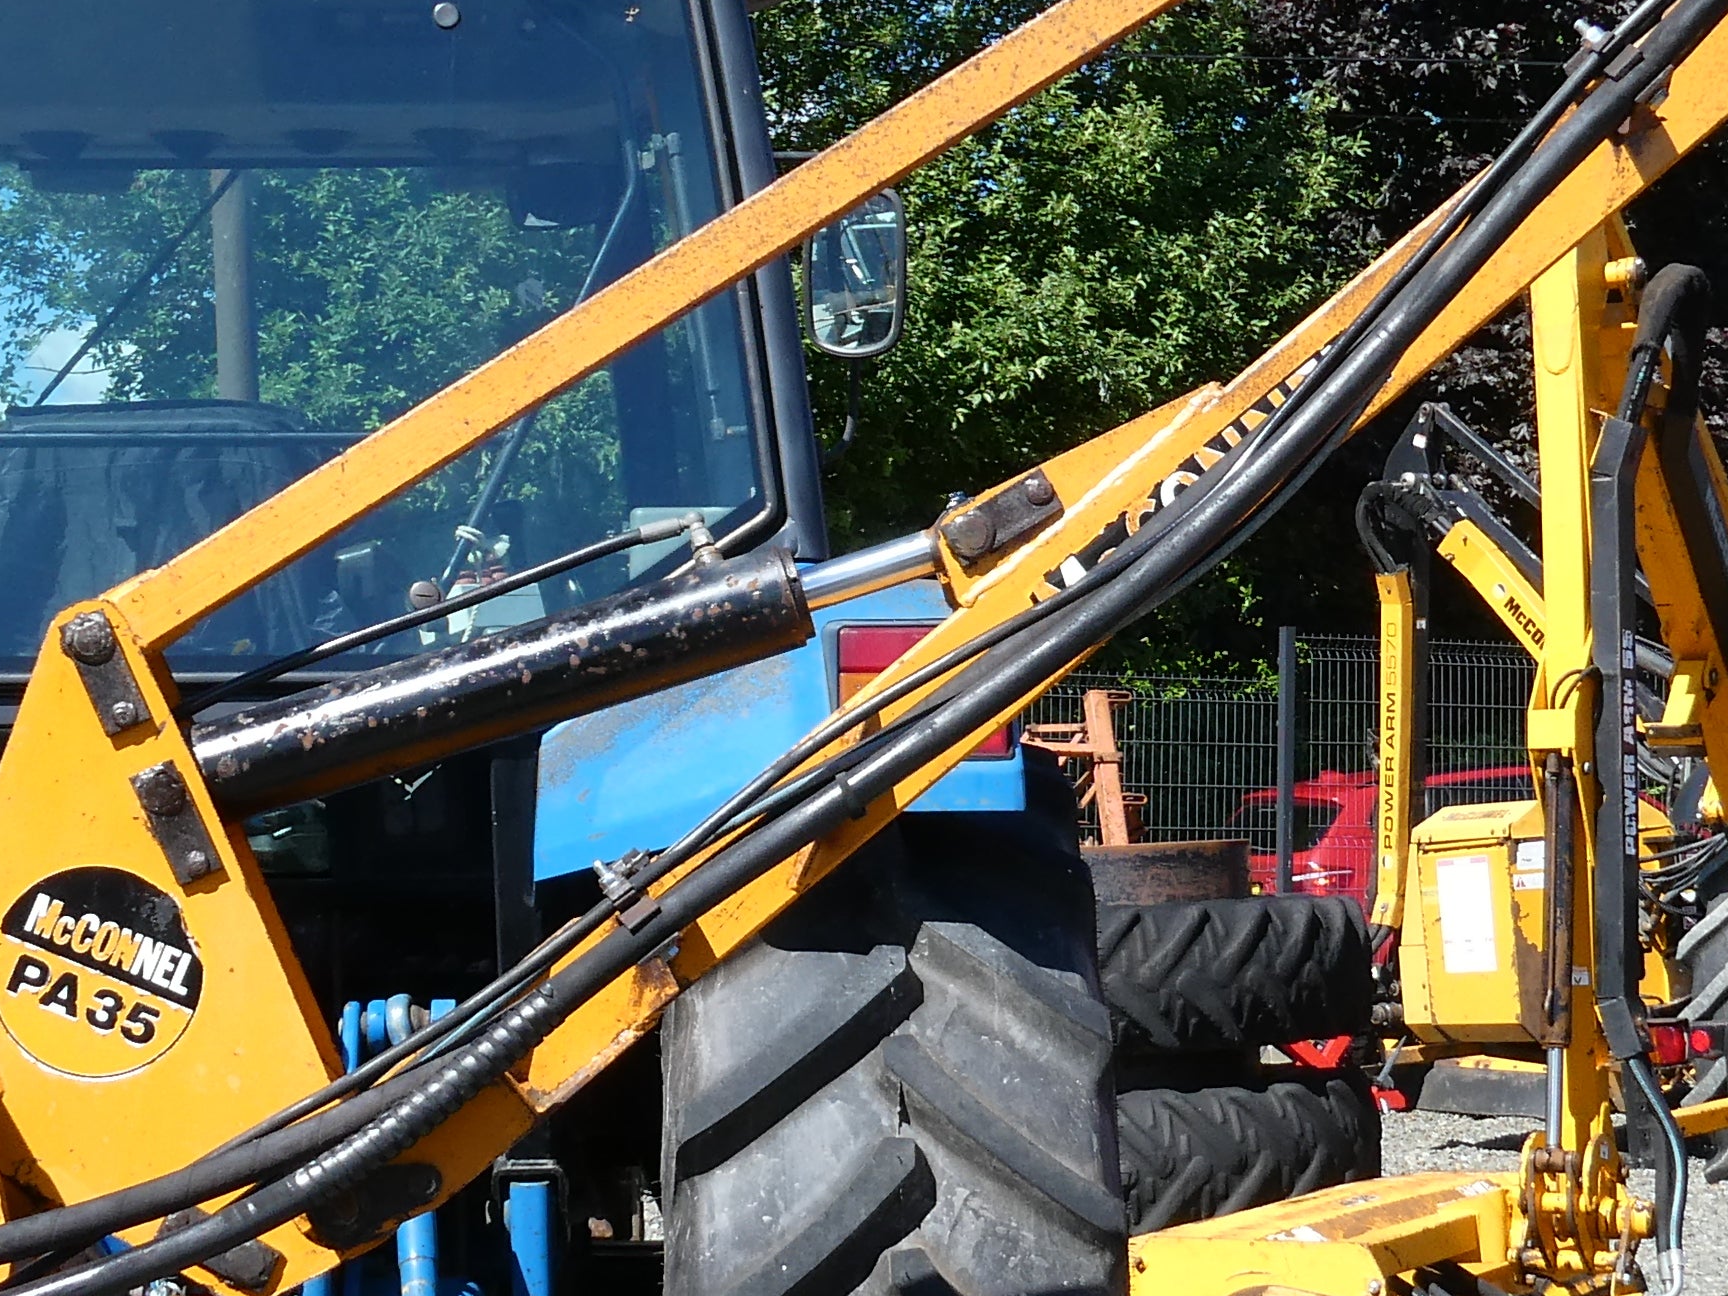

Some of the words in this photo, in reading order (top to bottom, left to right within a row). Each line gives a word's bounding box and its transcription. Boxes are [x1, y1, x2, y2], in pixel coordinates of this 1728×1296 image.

[1385, 622, 1397, 686] 5570
[1503, 595, 1546, 651] McCO
[1384, 691, 1396, 750] ARM
[1382, 755, 1395, 850] POWER
[1623, 754, 1637, 856] POWER
[24, 892, 193, 996] McCONNEL
